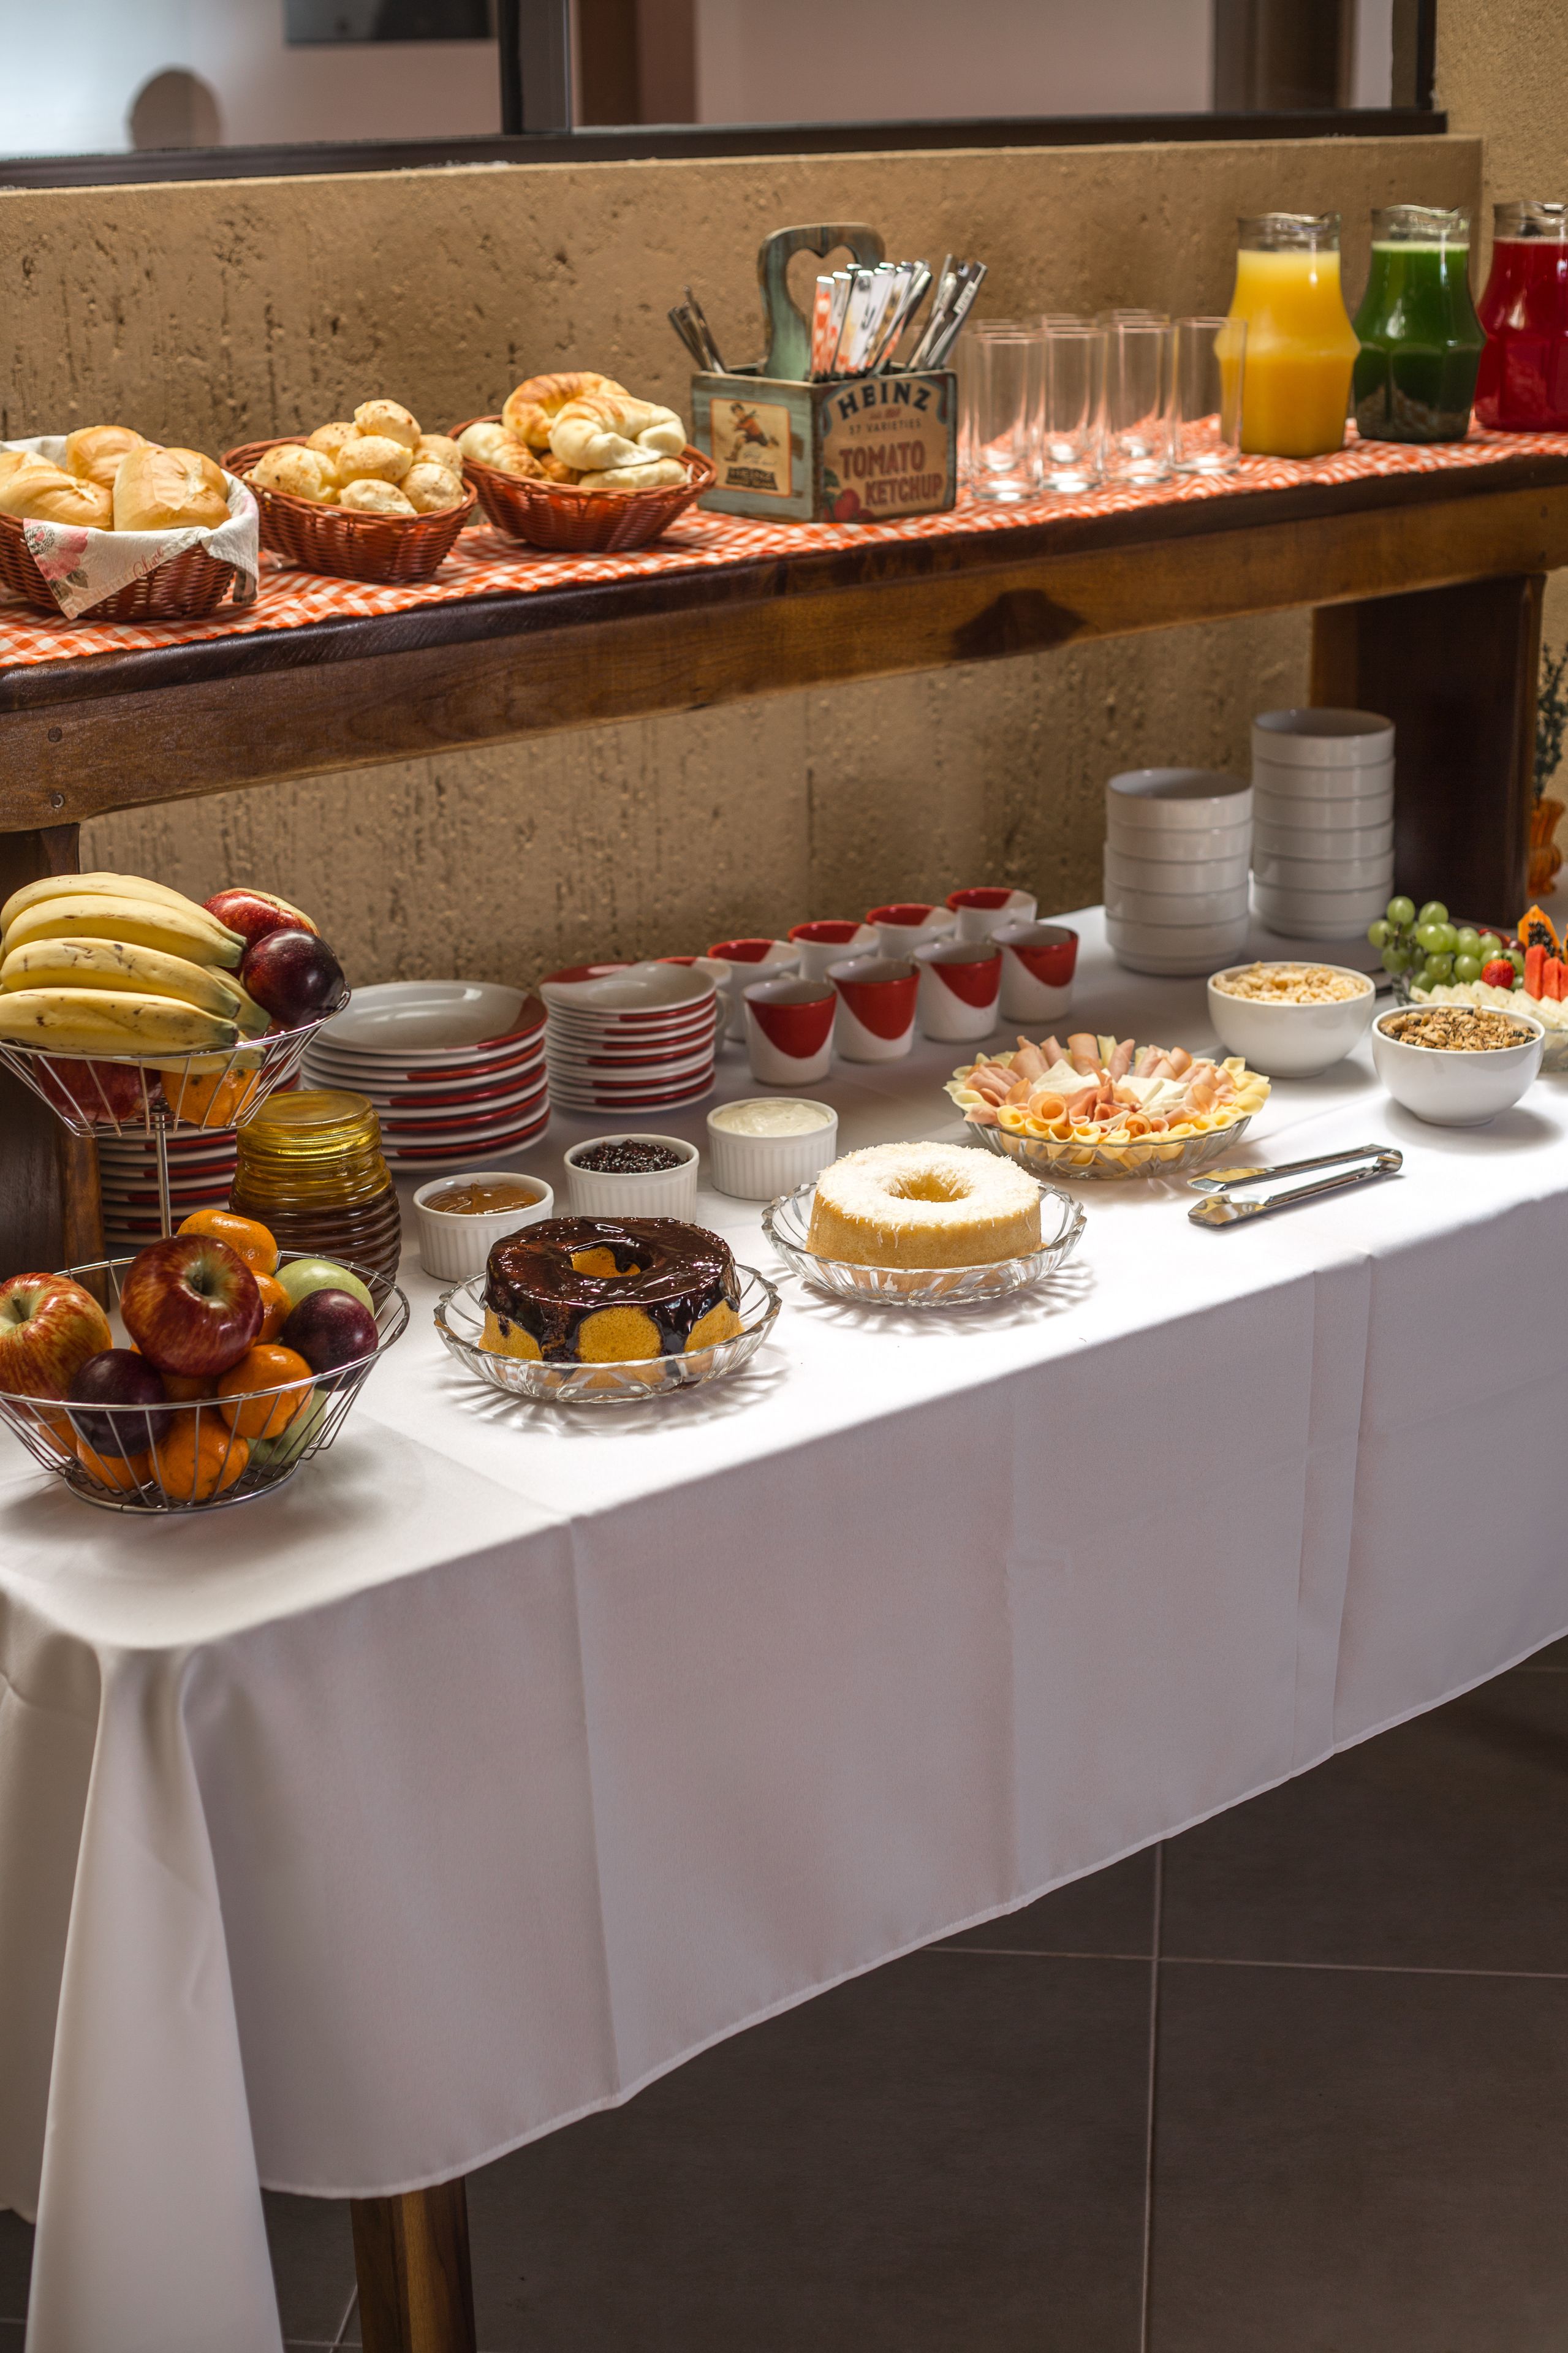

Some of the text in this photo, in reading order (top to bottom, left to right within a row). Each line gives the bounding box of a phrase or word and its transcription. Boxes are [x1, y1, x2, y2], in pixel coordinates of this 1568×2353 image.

[837, 382, 931, 421] HEINZ
[866, 418, 922, 433] VARIETIES
[839, 440, 925, 480] TOMATO
[865, 472, 943, 506] KETCHUP
